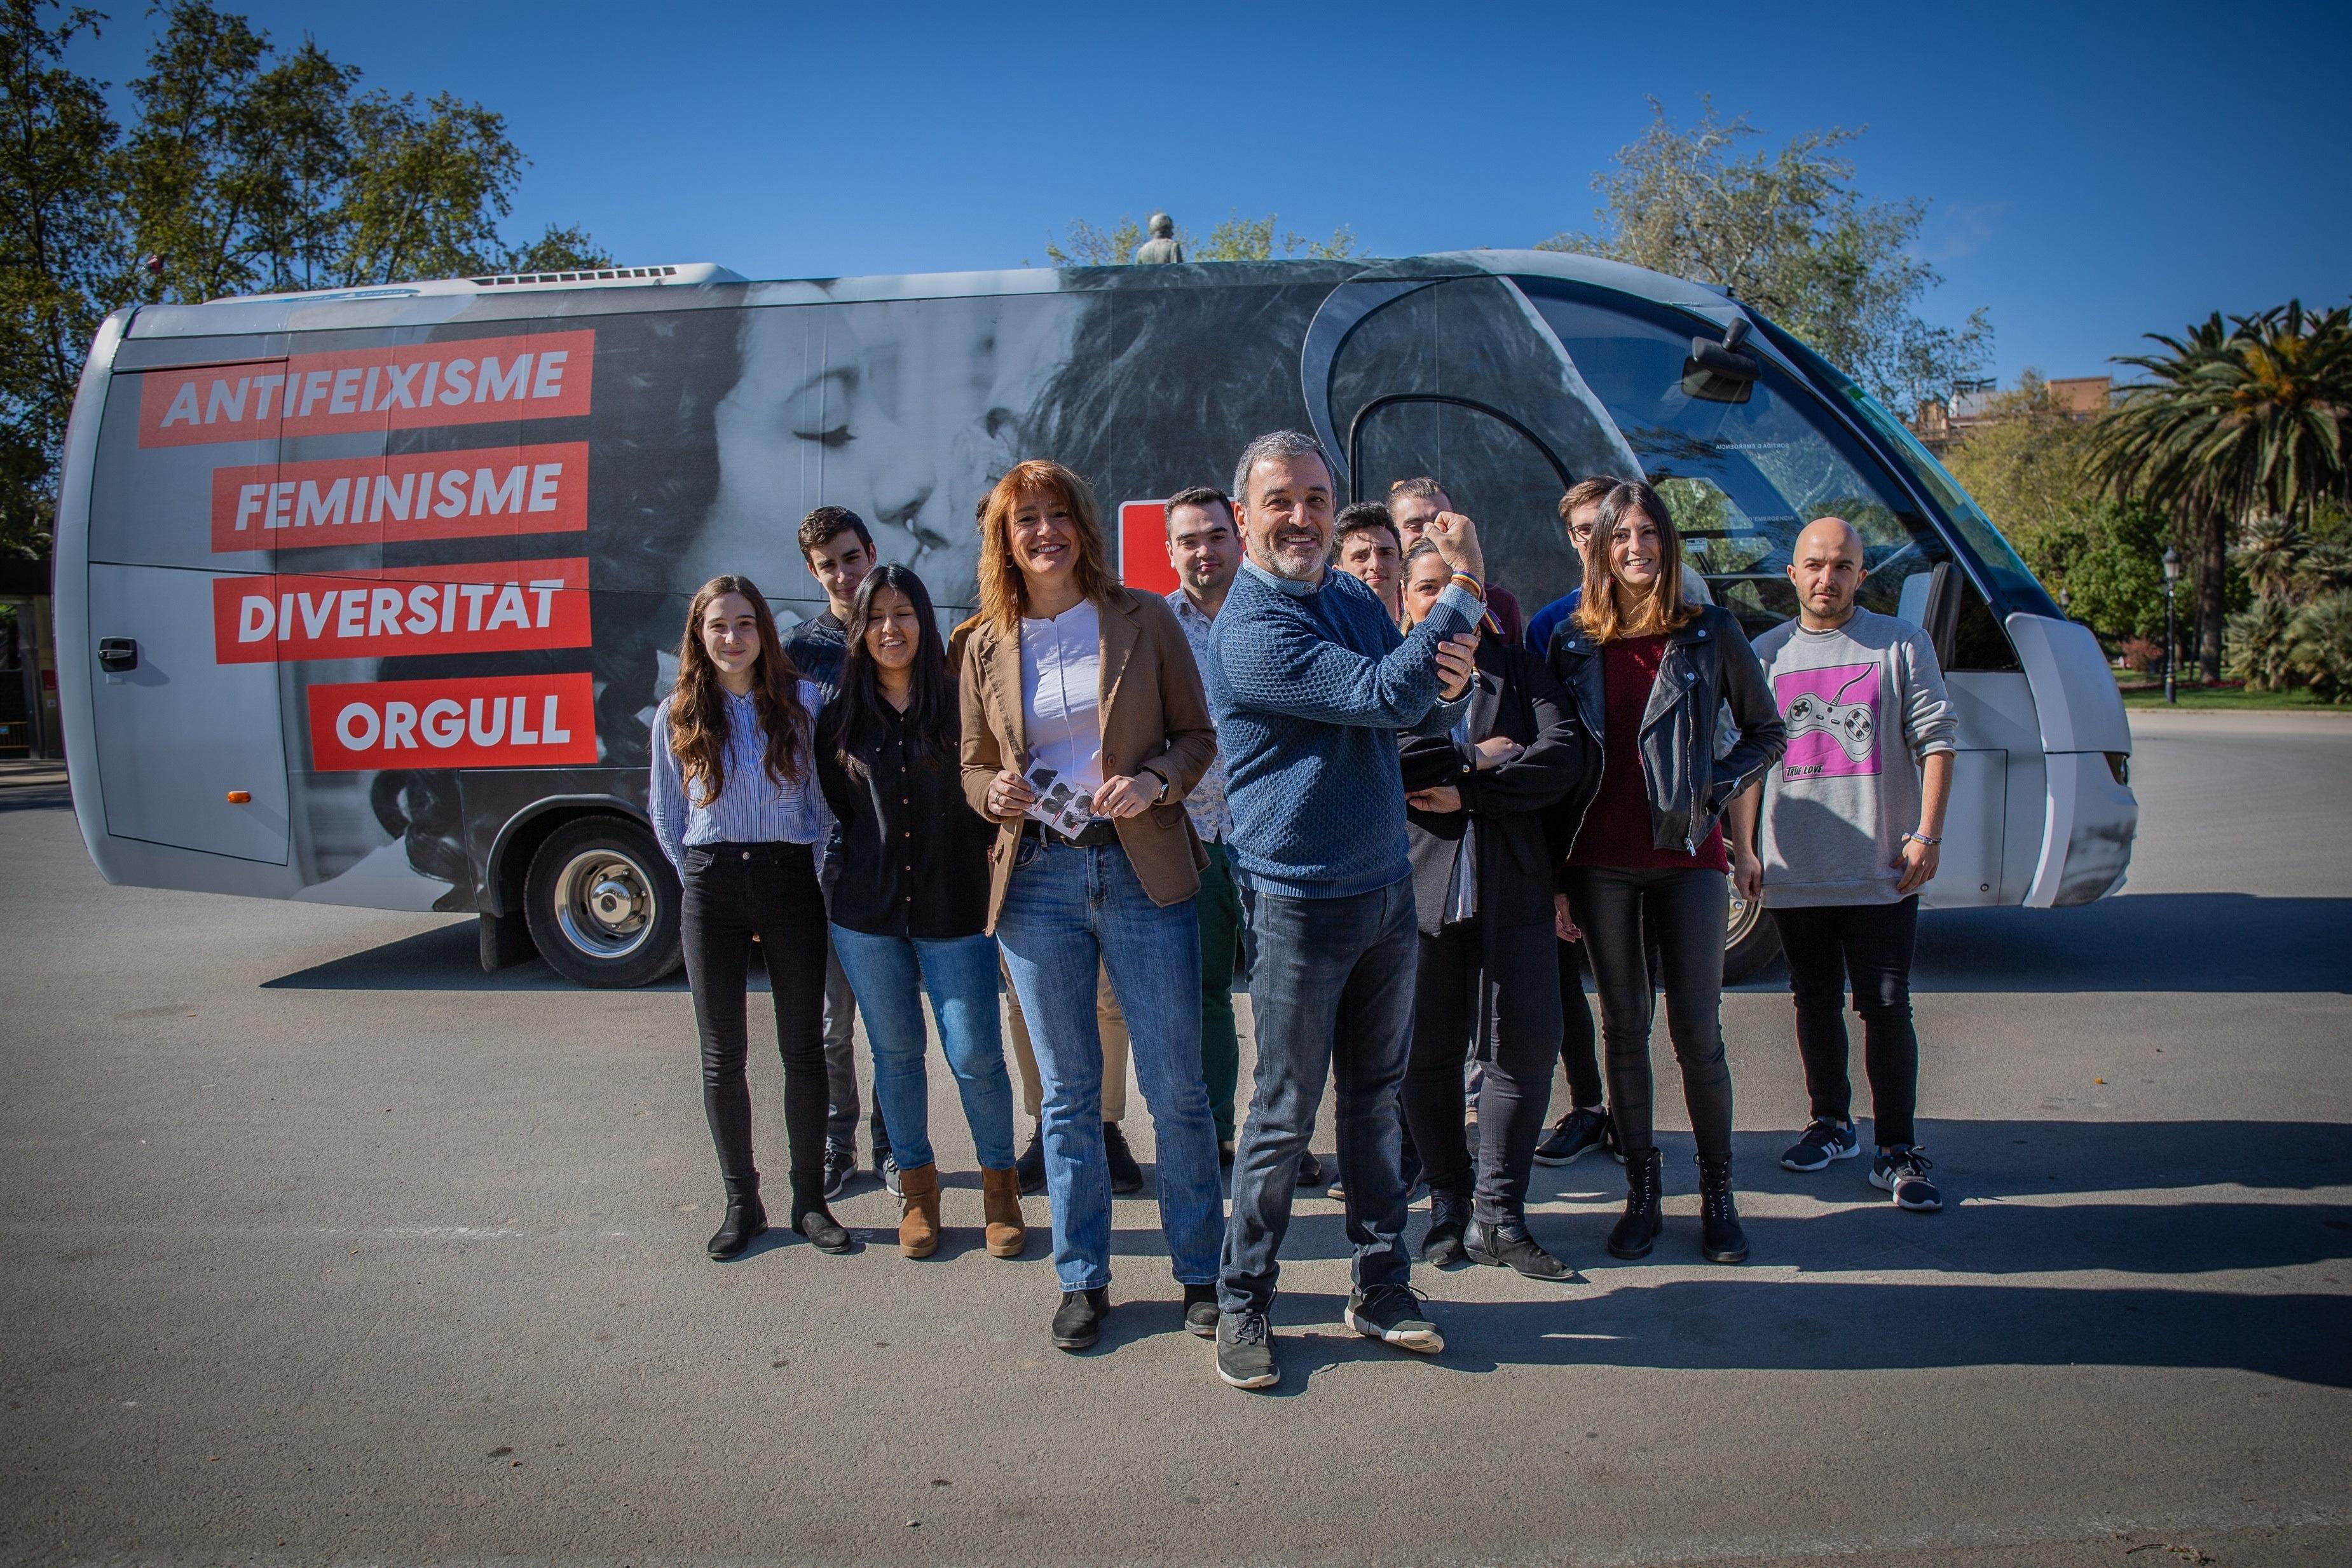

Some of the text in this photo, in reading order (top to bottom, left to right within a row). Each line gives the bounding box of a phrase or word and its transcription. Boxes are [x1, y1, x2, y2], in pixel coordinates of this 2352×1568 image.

[161, 351, 569, 427] ANTIFEIXISME
[235, 463, 563, 531] FEMINISME
[238, 579, 564, 643] DIVERSITAT
[336, 695, 570, 751] ORGULL
[1786, 765, 1823, 777] TRUE LOVE
